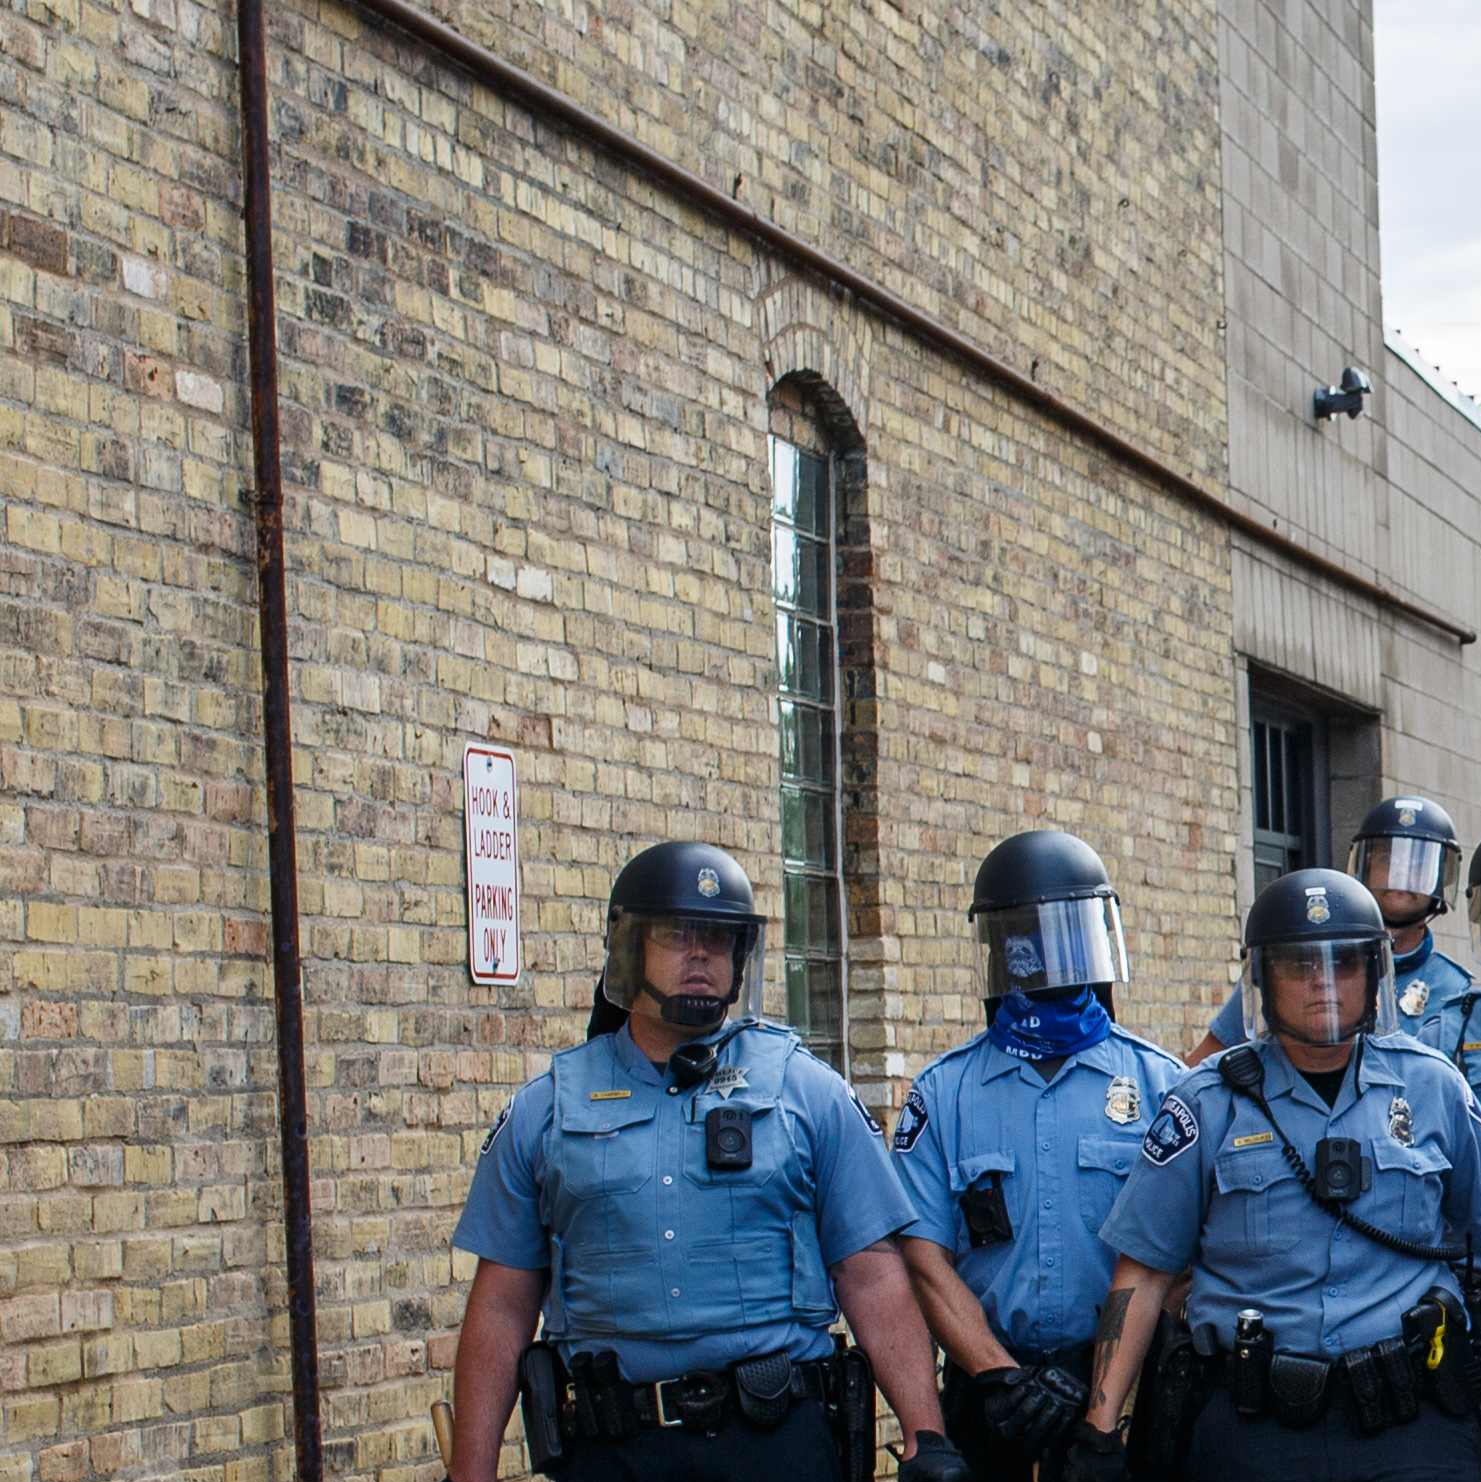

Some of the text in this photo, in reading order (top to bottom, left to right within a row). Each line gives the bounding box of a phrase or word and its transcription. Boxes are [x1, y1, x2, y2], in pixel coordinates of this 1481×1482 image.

[472, 786, 510, 818] HOOK &
[474, 830, 511, 861] LADDER
[476, 884, 513, 921] PARKING
[483, 929, 506, 963] ONLY
